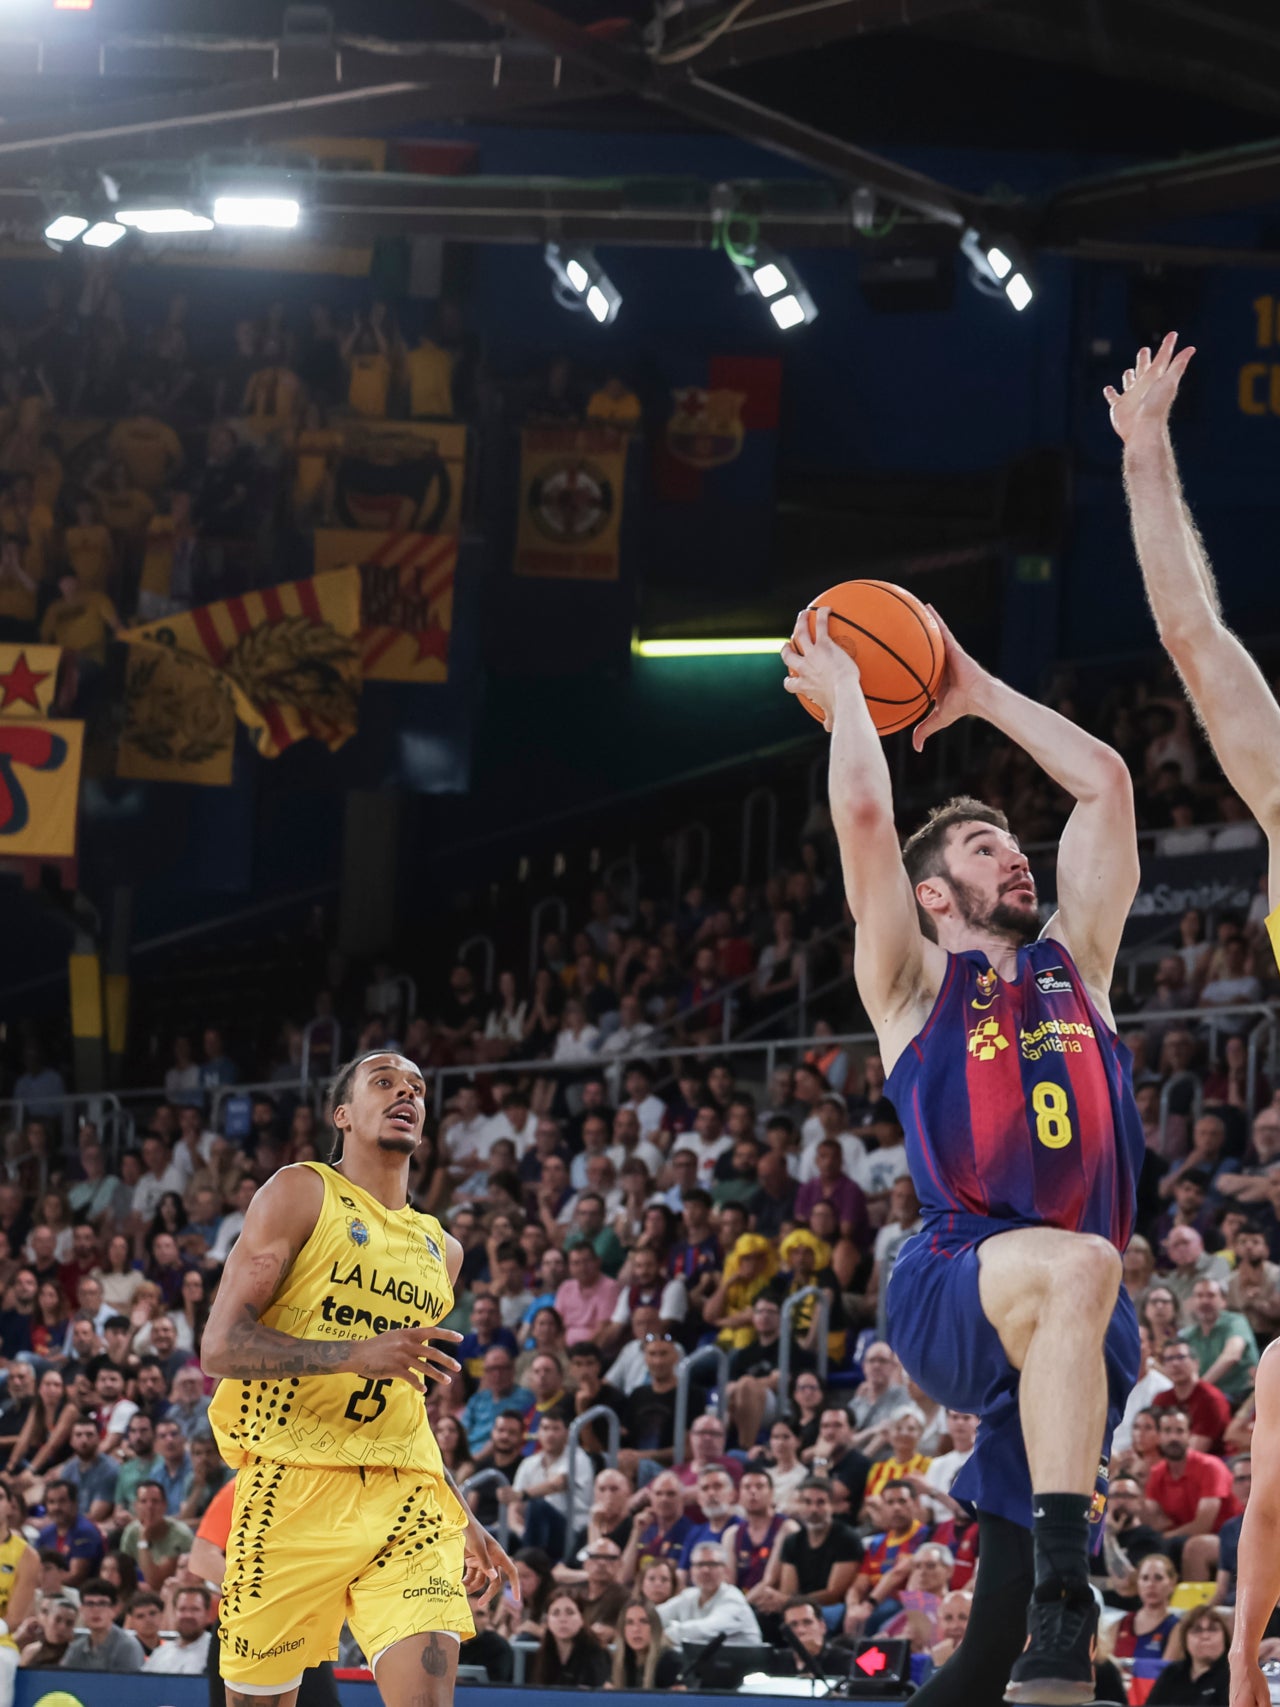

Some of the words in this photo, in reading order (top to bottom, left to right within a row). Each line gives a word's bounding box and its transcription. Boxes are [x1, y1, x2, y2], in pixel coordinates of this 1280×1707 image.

[1032, 1081, 1073, 1149] 8
[330, 1261, 363, 1289] LA
[369, 1269, 444, 1321] LAGUNA
[344, 1374, 394, 1424] 25
